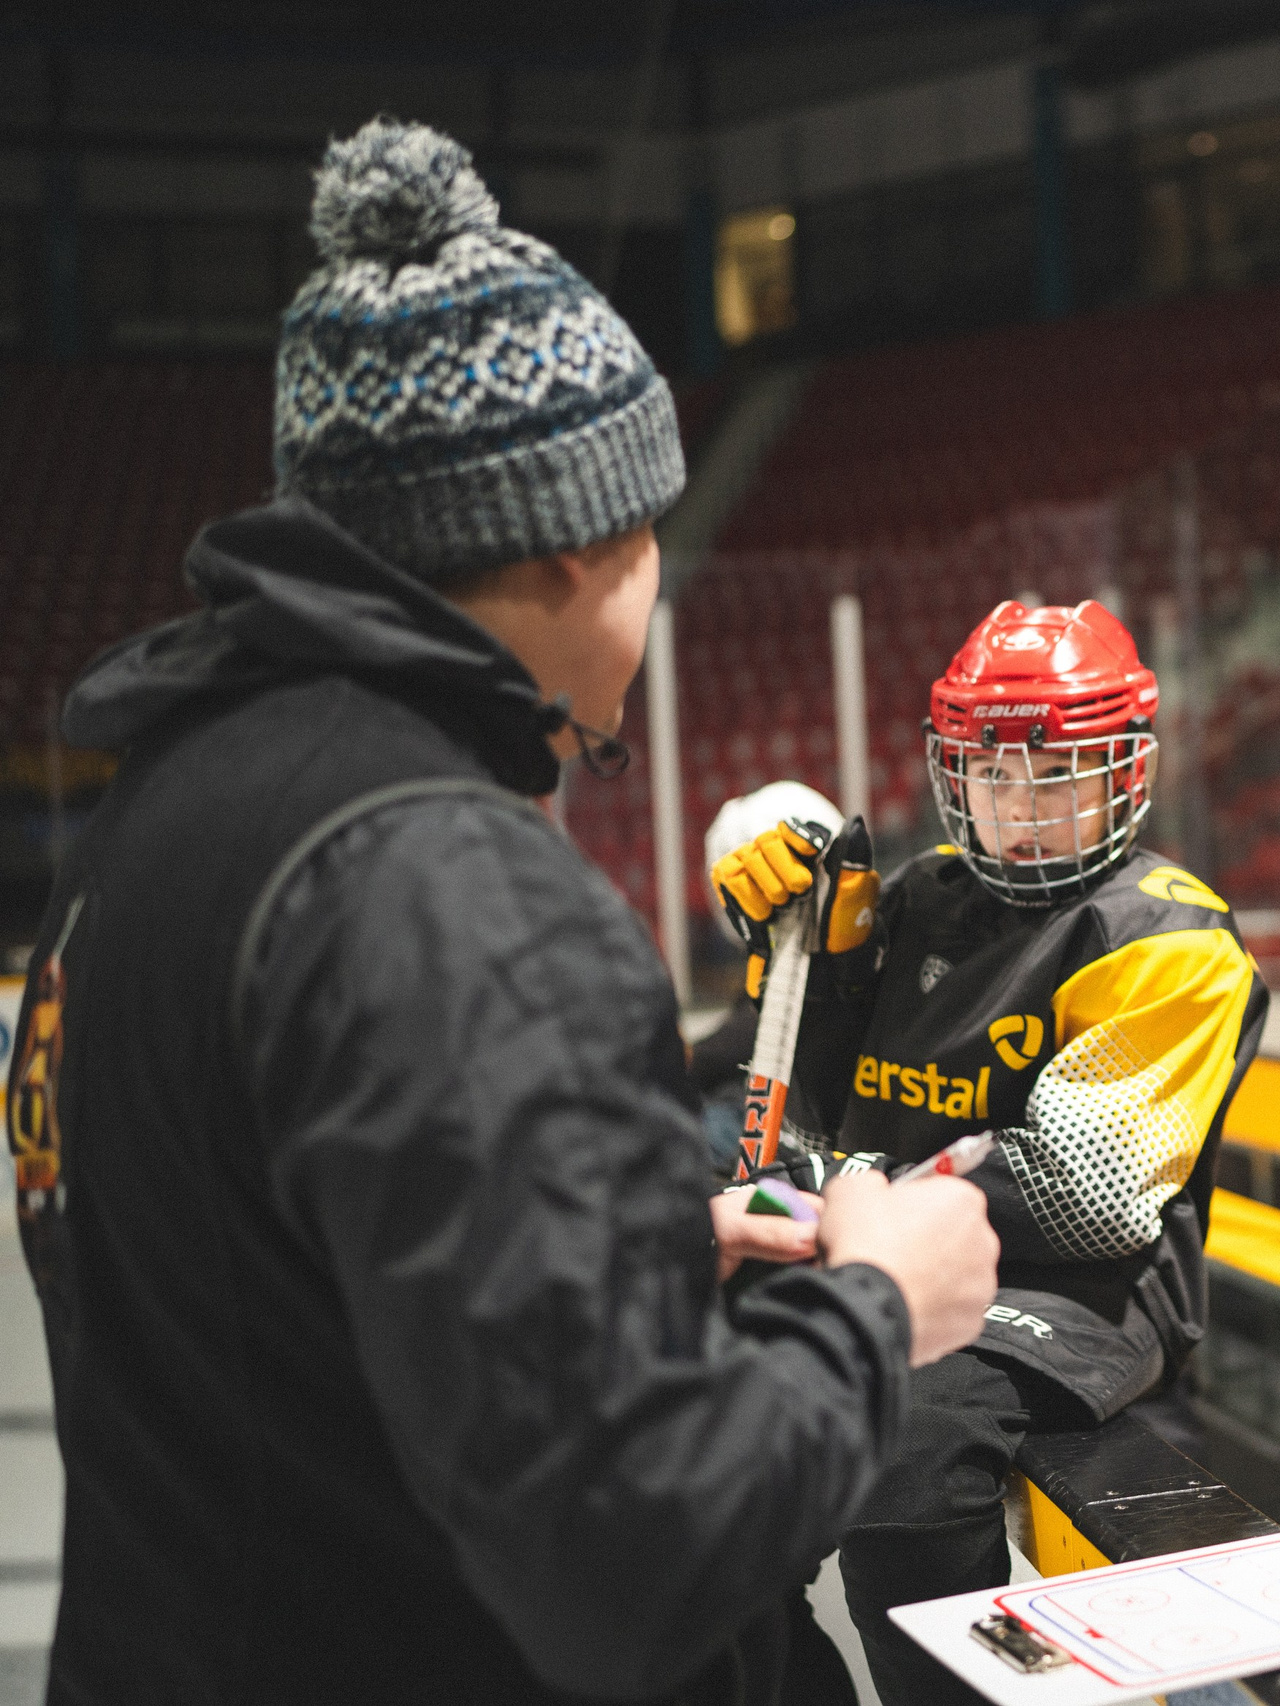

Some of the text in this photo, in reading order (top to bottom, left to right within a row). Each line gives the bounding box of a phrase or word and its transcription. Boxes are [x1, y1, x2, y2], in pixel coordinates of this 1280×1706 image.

[973, 703, 1050, 718] BAUER
[854, 1054, 991, 1119] erstal
[983, 1304, 1053, 1340] ER
